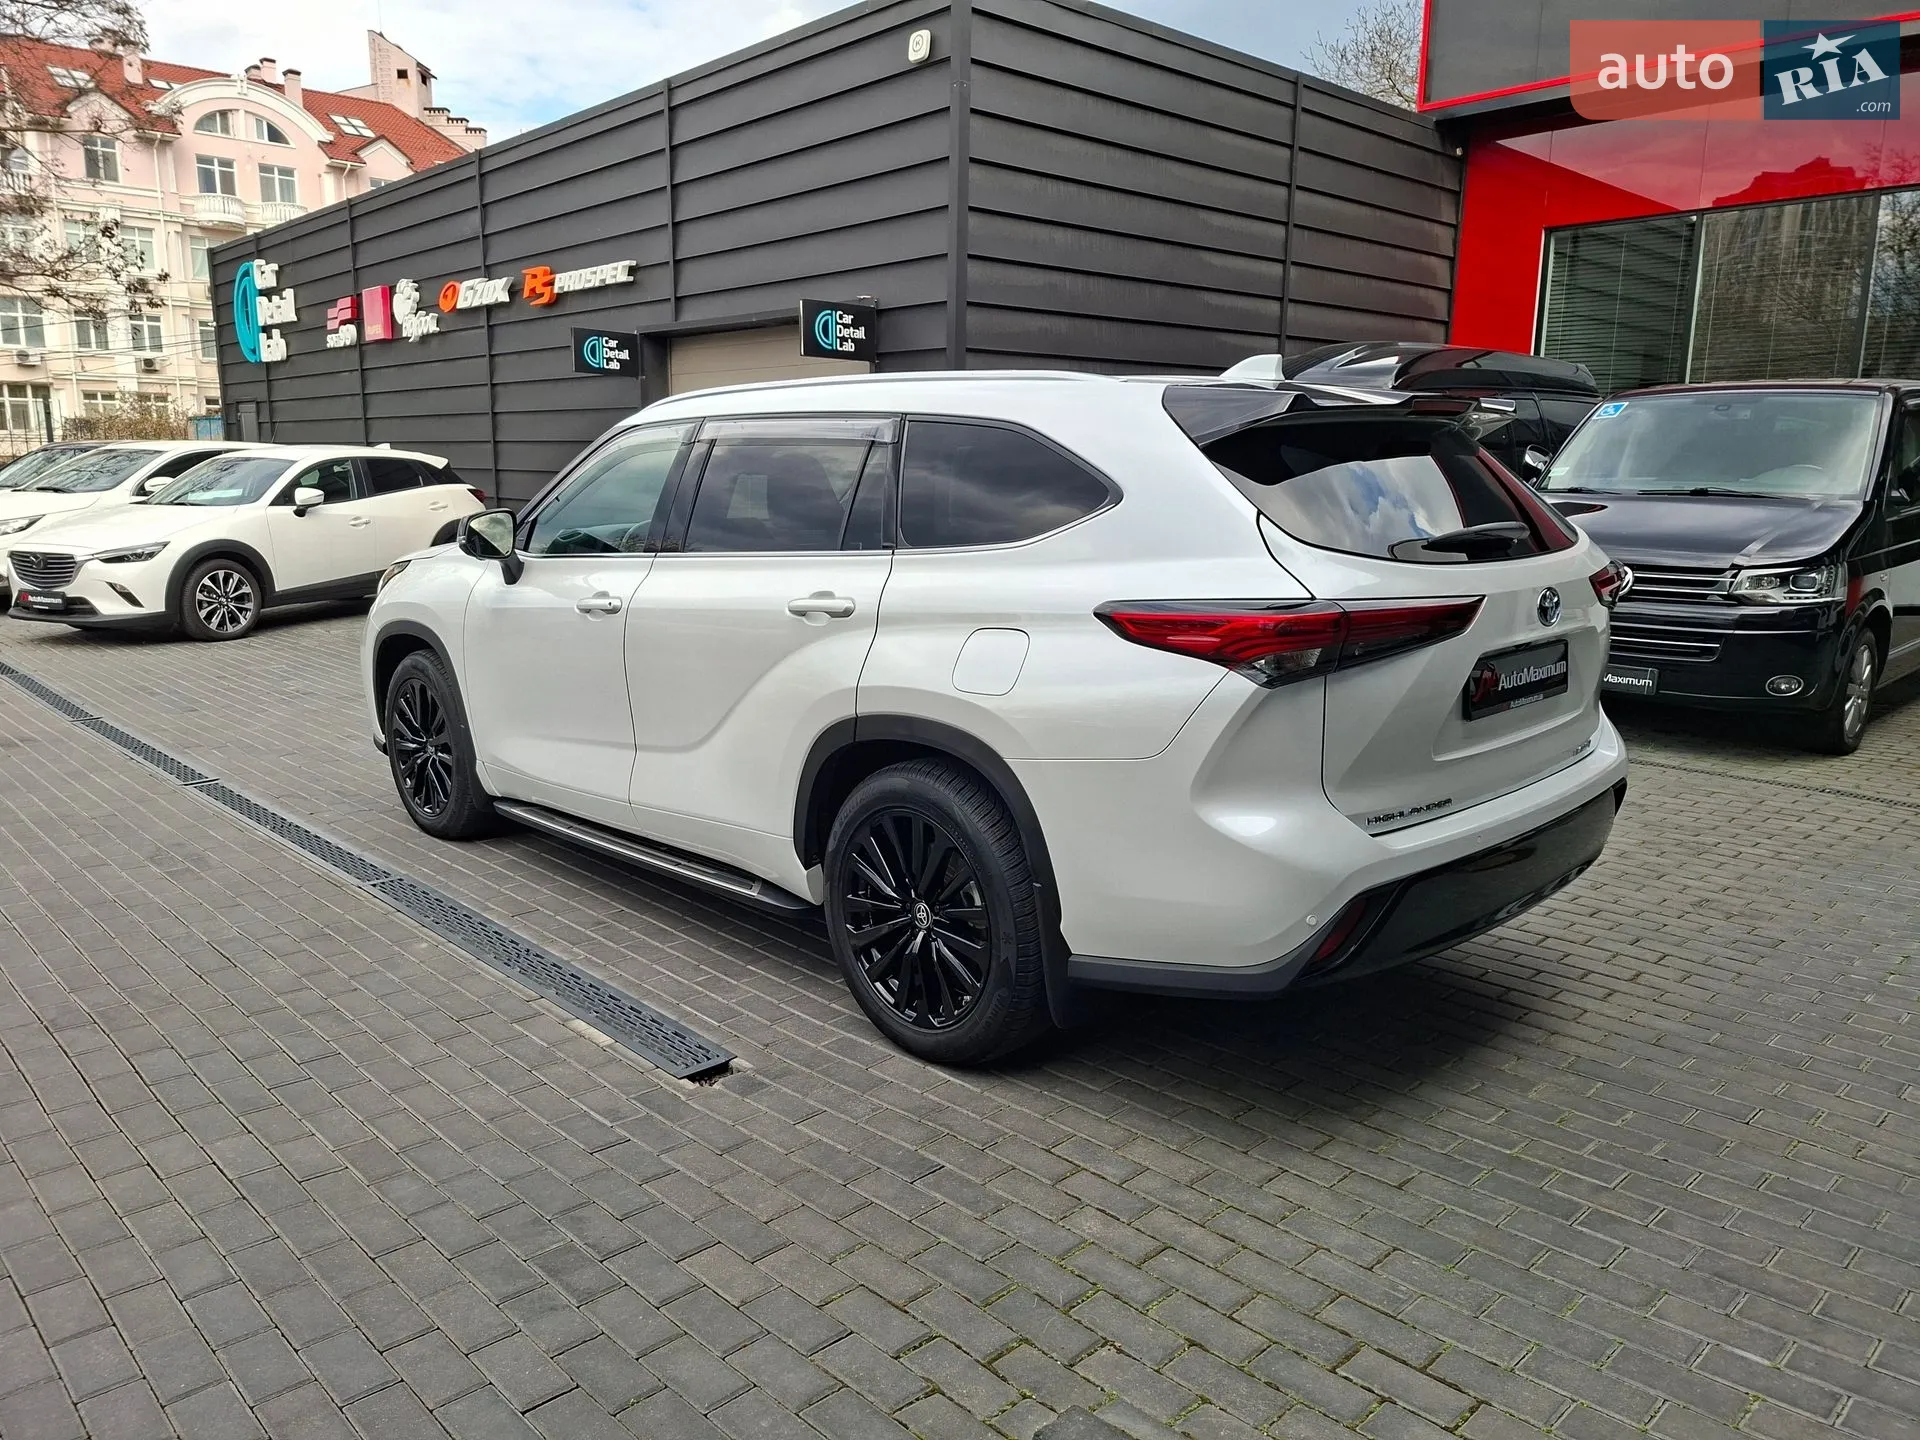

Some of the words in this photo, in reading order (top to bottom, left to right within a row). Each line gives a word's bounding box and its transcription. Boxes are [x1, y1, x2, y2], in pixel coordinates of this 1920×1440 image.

[254, 258, 279, 289] Car
[553, 260, 636, 293] PROSPEC
[256, 288, 297, 326] Detail
[836, 311, 853, 324] Car
[837, 325, 865, 339] Detail
[259, 328, 287, 363] Lab
[603, 337, 618, 347] Car
[837, 339, 855, 351] Lab
[603, 348, 630, 360] Detail
[604, 359, 620, 369] Lab
[1498, 660, 1567, 691] AutoMaximum
